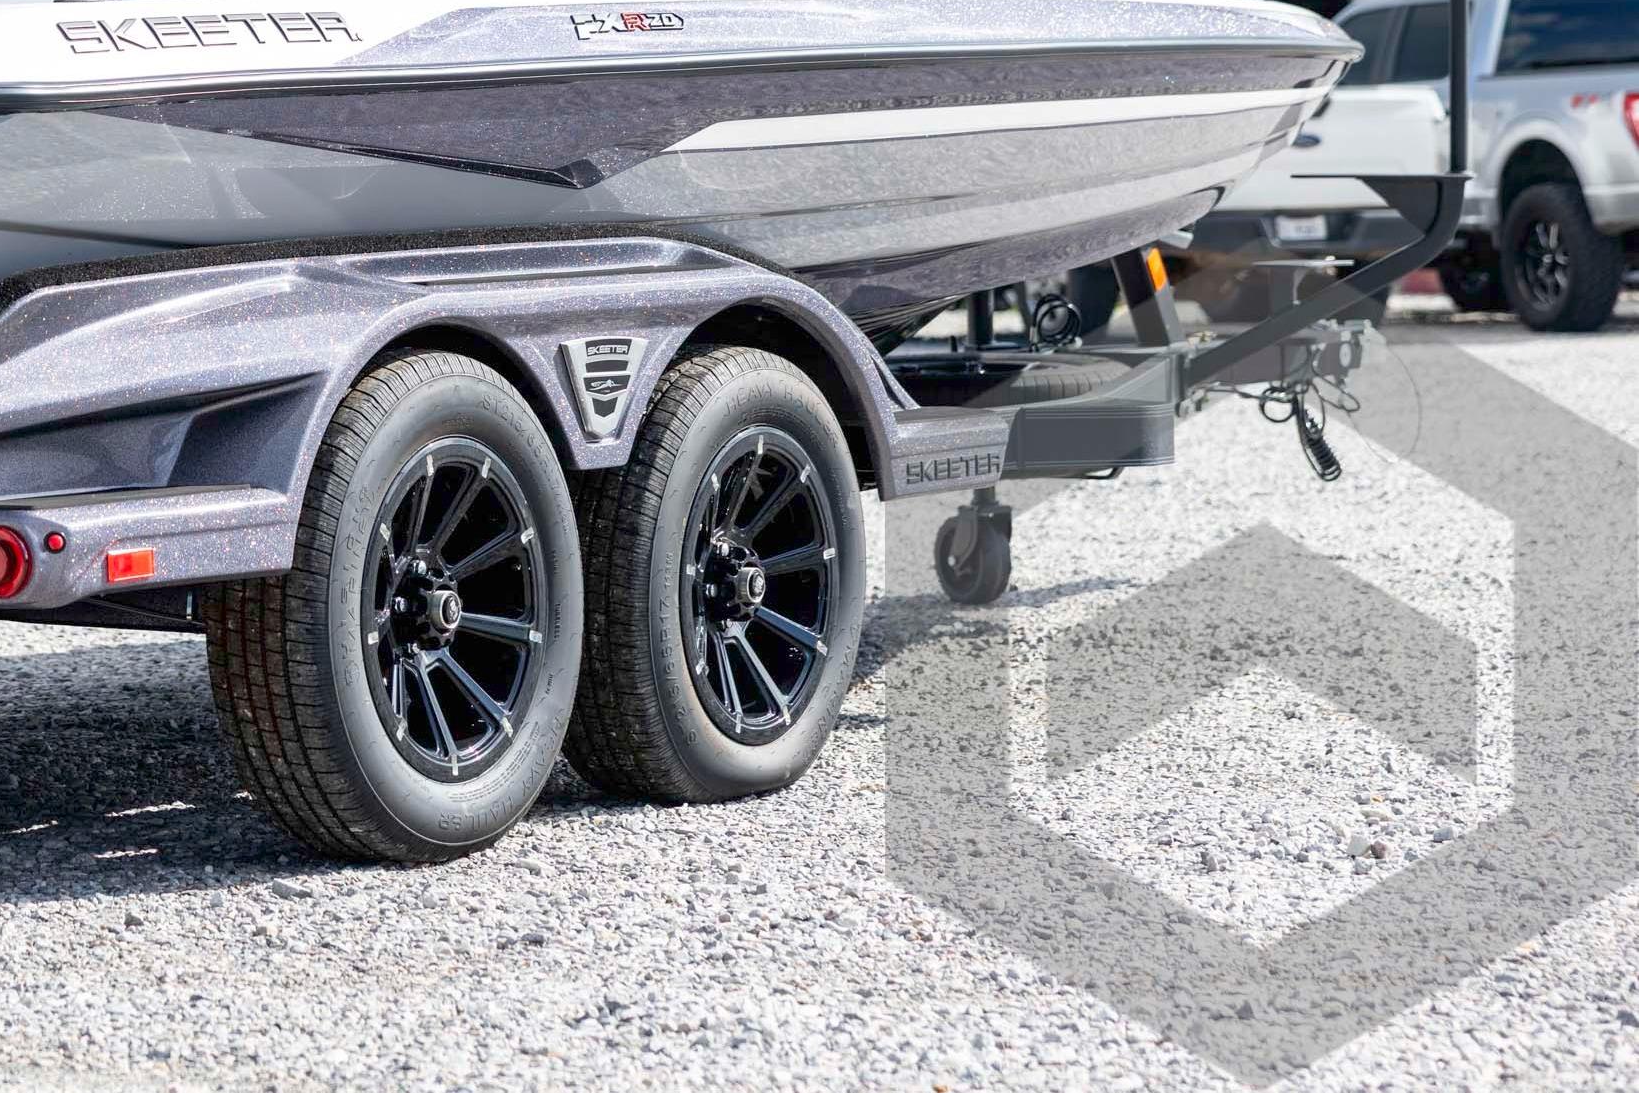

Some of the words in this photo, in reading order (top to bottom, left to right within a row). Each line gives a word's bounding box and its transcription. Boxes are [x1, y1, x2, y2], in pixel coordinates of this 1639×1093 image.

[56, 11, 360, 54] SKEETER
[587, 345, 629, 355] SKEETER
[905, 453, 1000, 484] SKEETER
